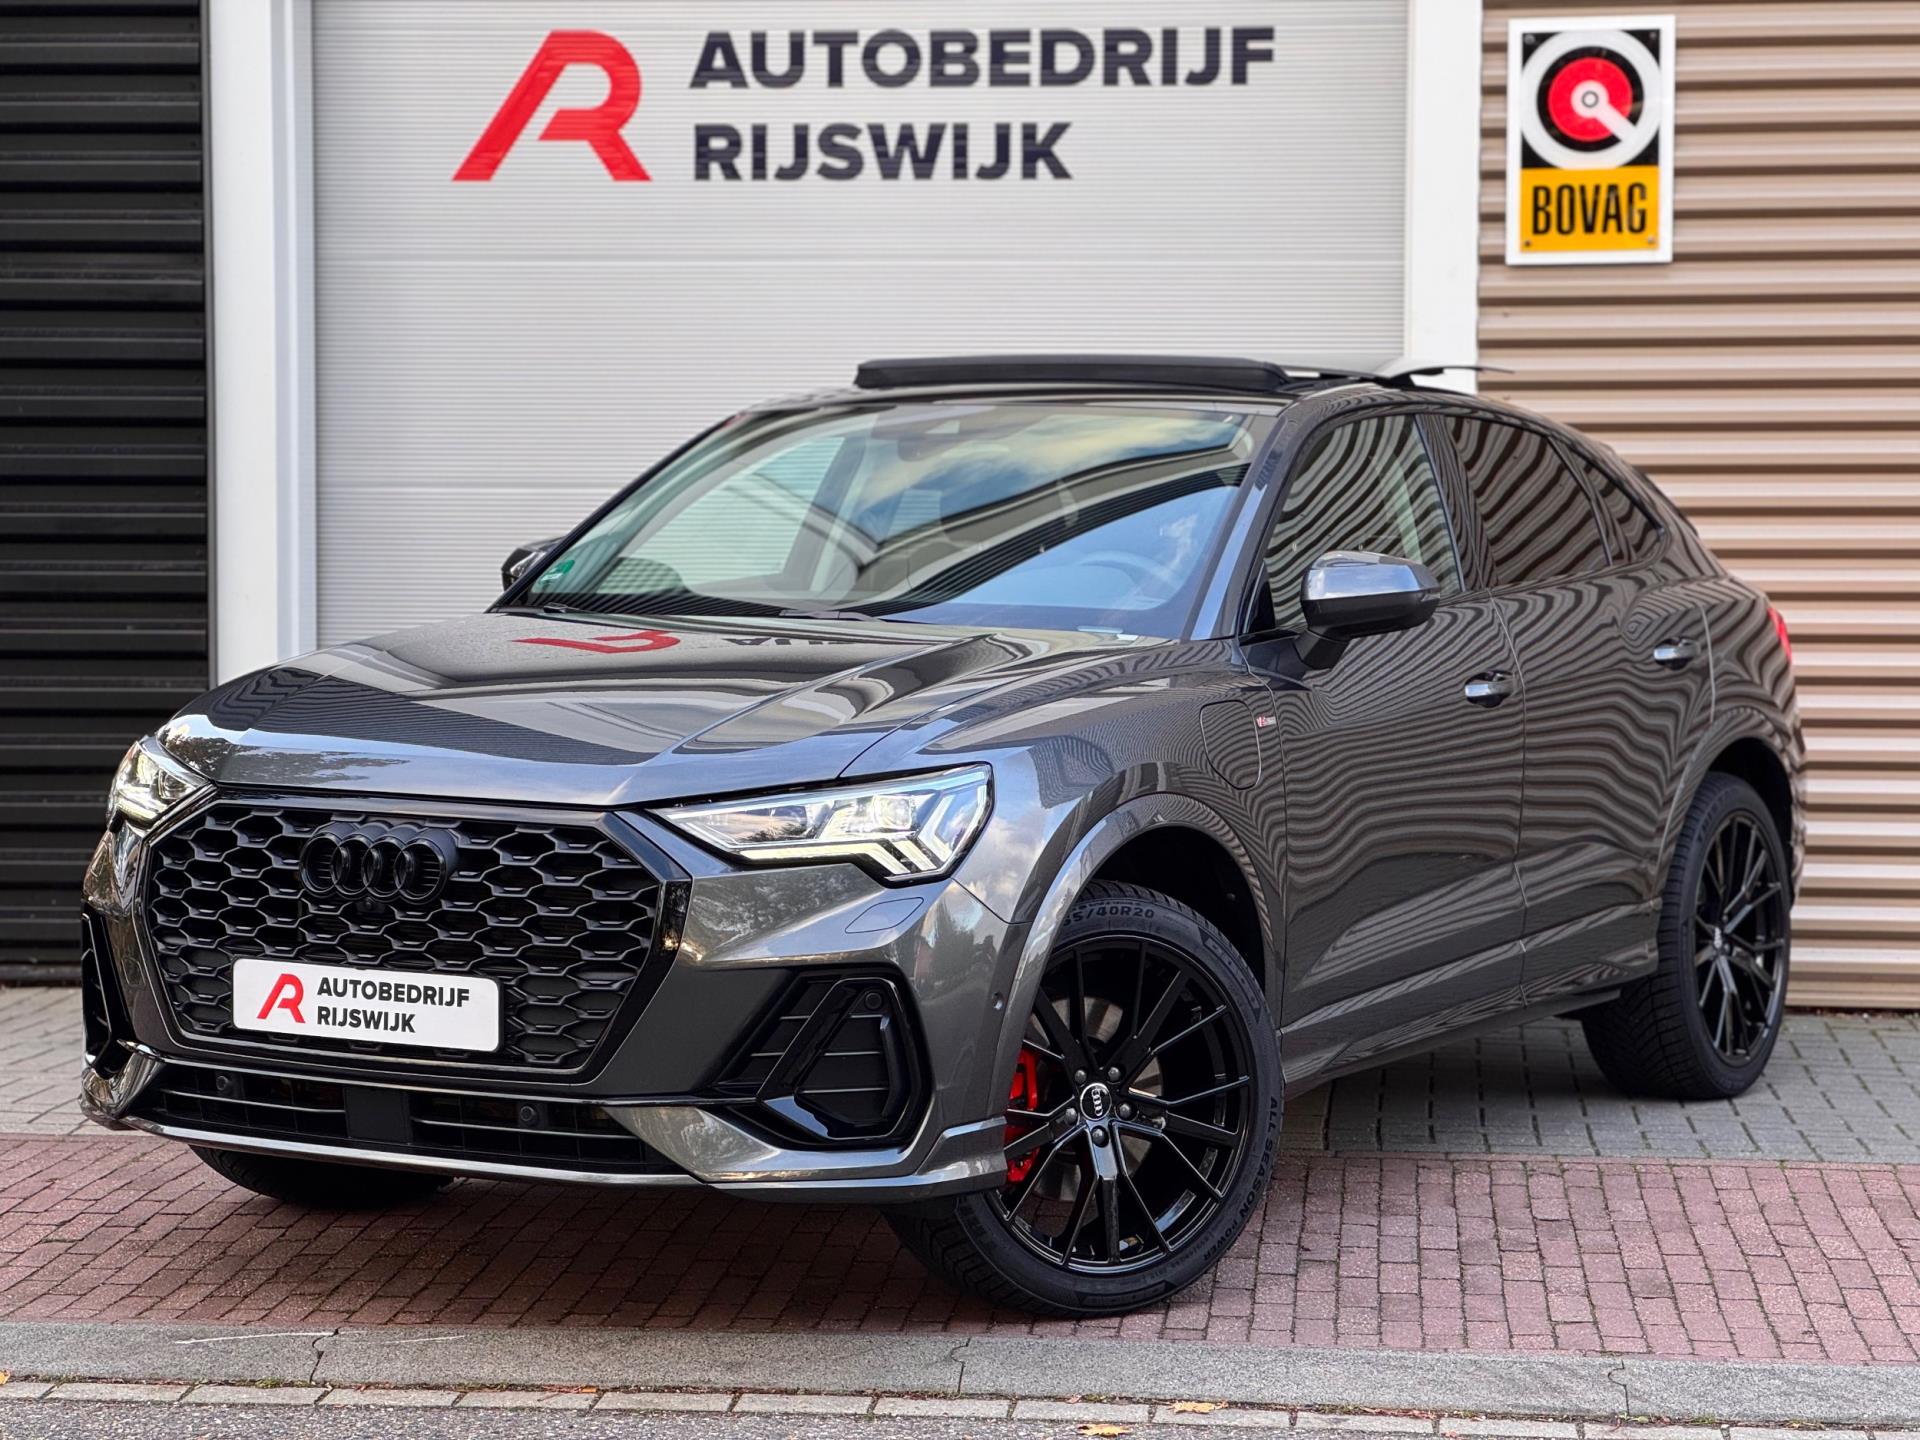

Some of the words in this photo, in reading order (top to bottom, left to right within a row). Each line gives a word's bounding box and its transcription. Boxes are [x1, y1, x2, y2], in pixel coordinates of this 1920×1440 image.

[690, 27, 1275, 89] AUTOBEDRIJF
[694, 122, 1073, 181] RIJSWIJK
[1532, 182, 1647, 236] BOVAG
[317, 977, 470, 1008] AUTOBEDRIJF
[317, 1006, 416, 1033] RIJSWIJK
[1267, 1096, 1278, 1133] ALL
[1239, 1138, 1273, 1218] SEASON
